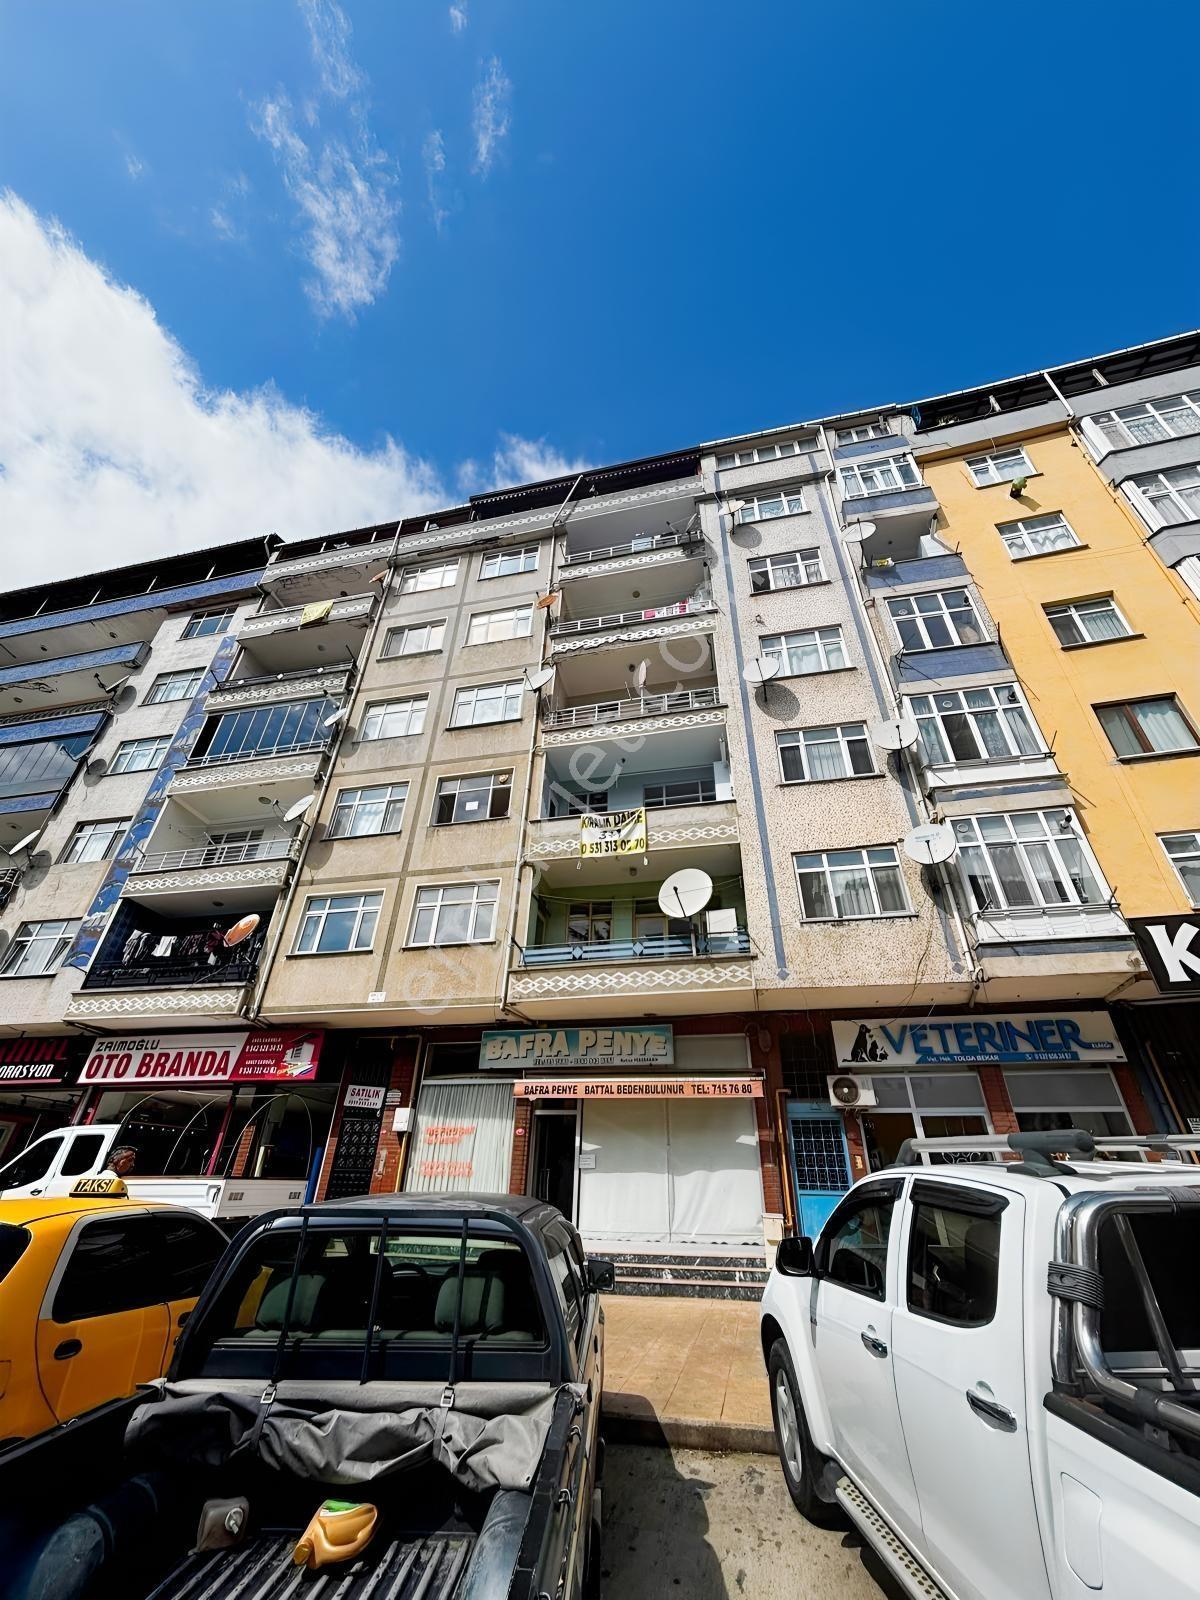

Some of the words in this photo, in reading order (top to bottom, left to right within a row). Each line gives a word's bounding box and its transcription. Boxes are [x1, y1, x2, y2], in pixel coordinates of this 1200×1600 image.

[581, 844, 587, 855] 0
[590, 842, 602, 854] 531
[604, 840, 618, 852] 313
[635, 838, 645, 849] 70
[486, 1031, 570, 1060] BAFRA
[578, 1030, 668, 1057] PENYE
[85, 1053, 132, 1079] OTO
[135, 1050, 231, 1078] BRANDA
[351, 1088, 381, 1099] SATILIK
[524, 1085, 549, 1095] BAFRA
[551, 1085, 578, 1095] PENYE
[584, 1085, 614, 1095] BATTAL
[691, 1084, 709, 1094] TEL:
[712, 1084, 727, 1094] 715
[729, 1084, 740, 1094] 76
[741, 1084, 752, 1094] 80
